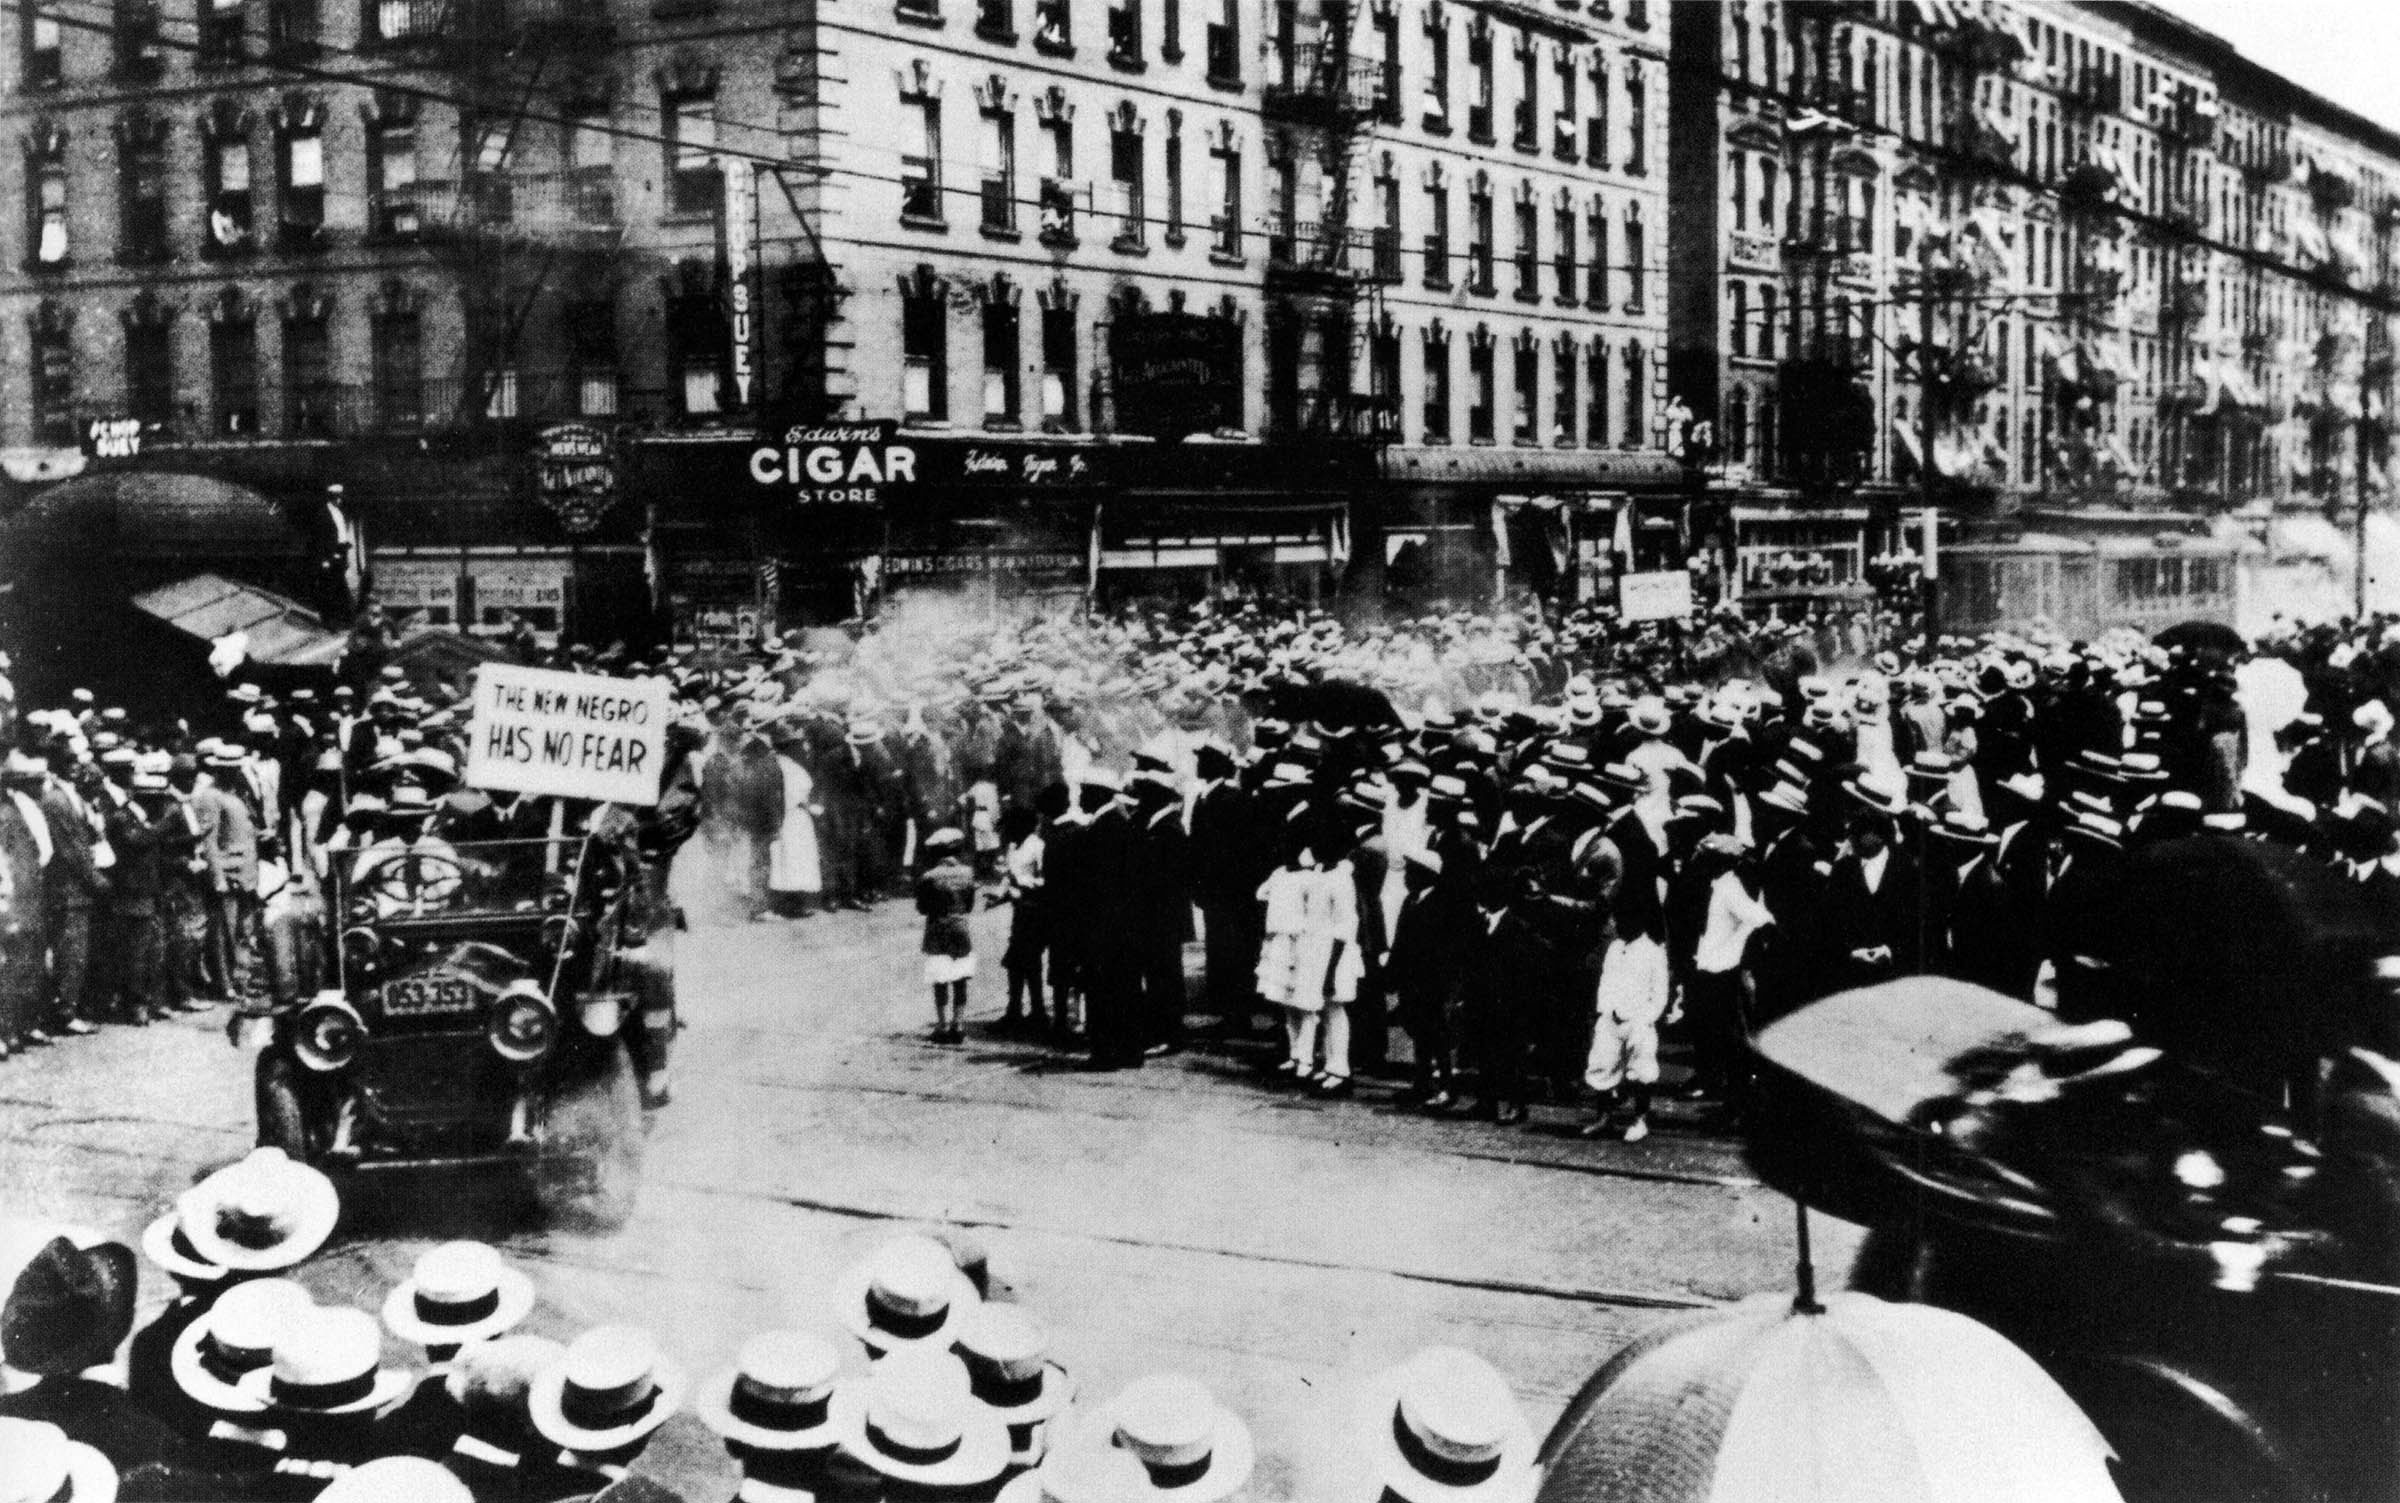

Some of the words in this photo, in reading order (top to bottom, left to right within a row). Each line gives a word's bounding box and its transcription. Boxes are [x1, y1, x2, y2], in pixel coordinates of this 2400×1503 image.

[785, 425, 882, 443] Edwin's
[750, 446, 916, 484] CIGAR
[798, 488, 877, 503] STORE
[494, 684, 527, 712] THE
[533, 690, 569, 715] NEW
[576, 695, 648, 725] NEGRO
[488, 724, 533, 763] HAS
[544, 730, 574, 766] NO
[581, 732, 647, 773] FEAR
